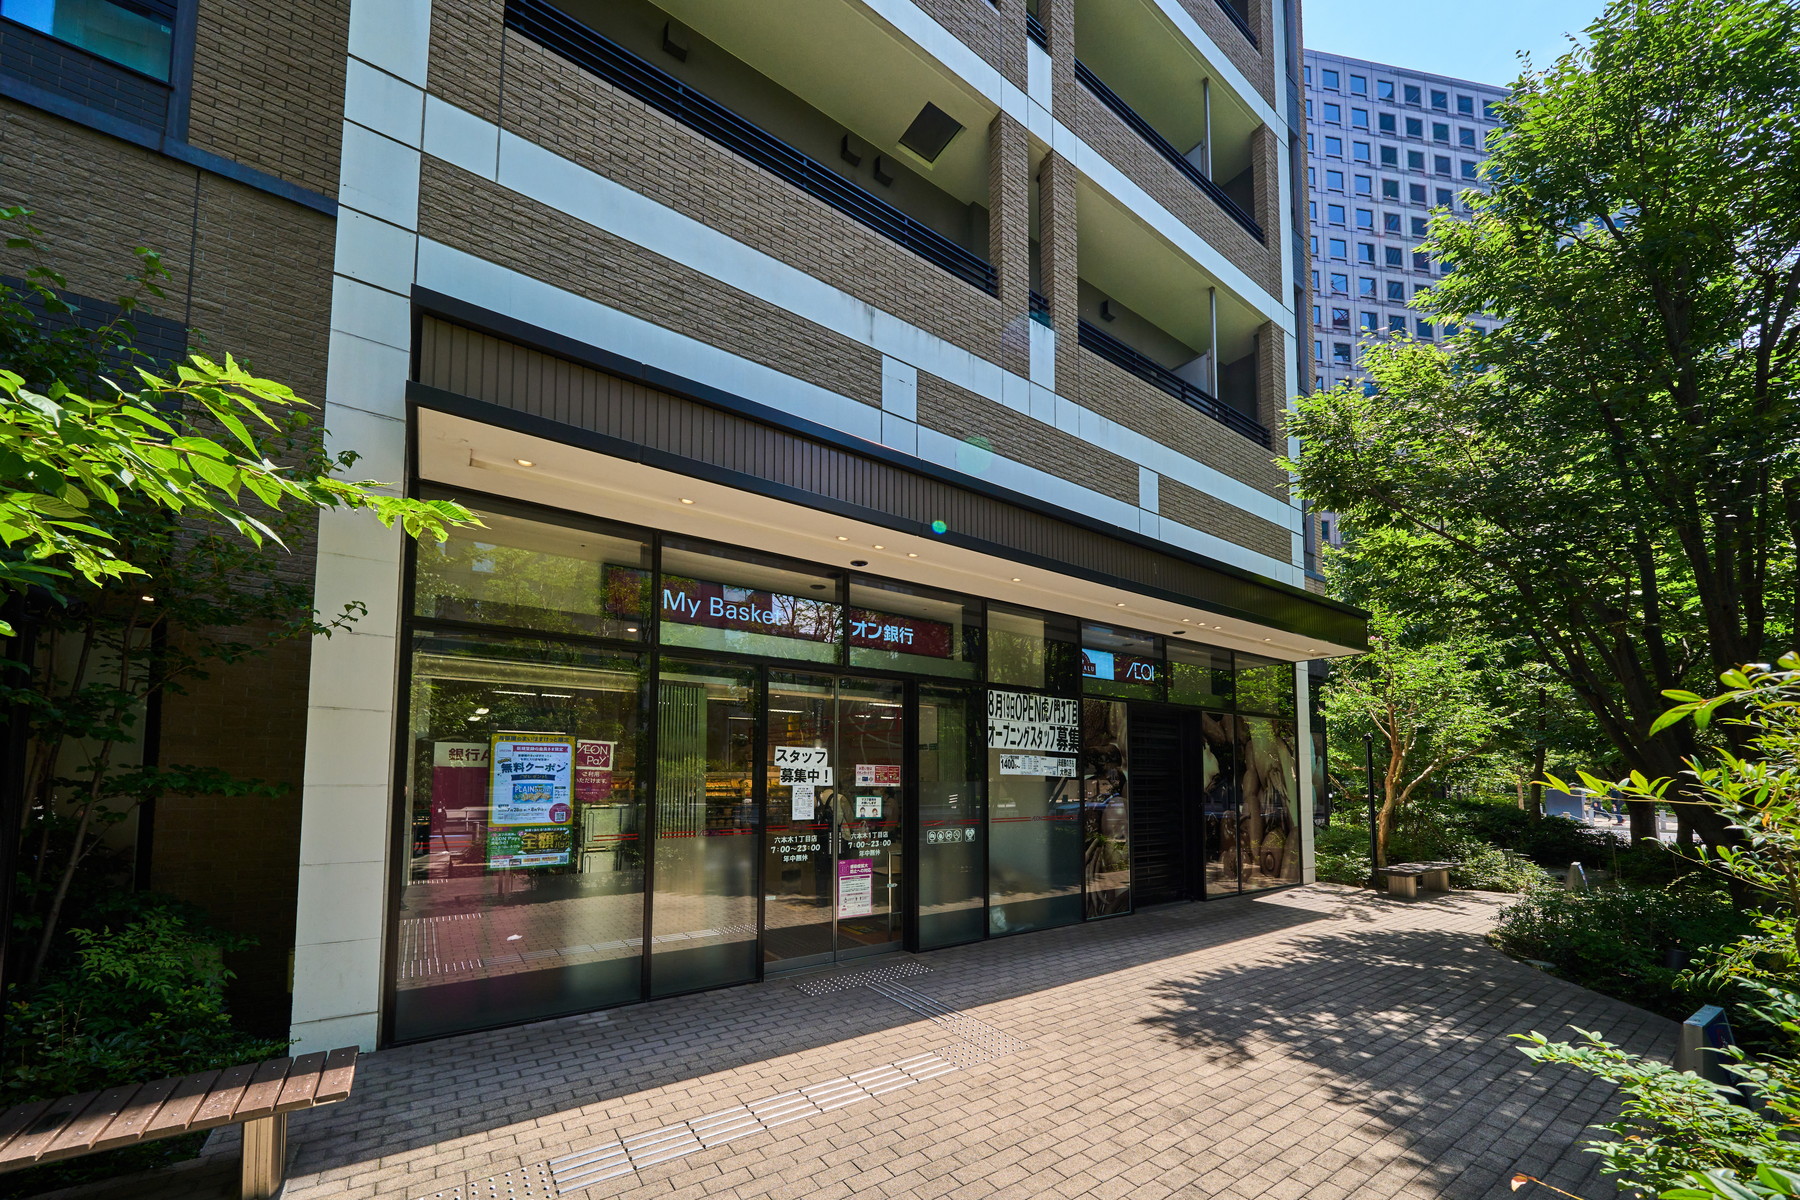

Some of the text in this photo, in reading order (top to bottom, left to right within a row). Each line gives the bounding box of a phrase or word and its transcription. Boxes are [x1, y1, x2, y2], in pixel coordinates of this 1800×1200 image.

[663, 589, 782, 626] My Basket
[849, 620, 914, 645] オン銀行
[988, 721, 1079, 752] オープニングスタッフ募集
[587, 755, 607, 766] Pay
[776, 749, 826, 764] スタッフ
[501, 762, 566, 773] 無料クーポン
[780, 767, 828, 783] 募集中!
[774, 835, 817, 844] 六本木1丁目店
[850, 831, 889, 839] 六本木1丁目店
